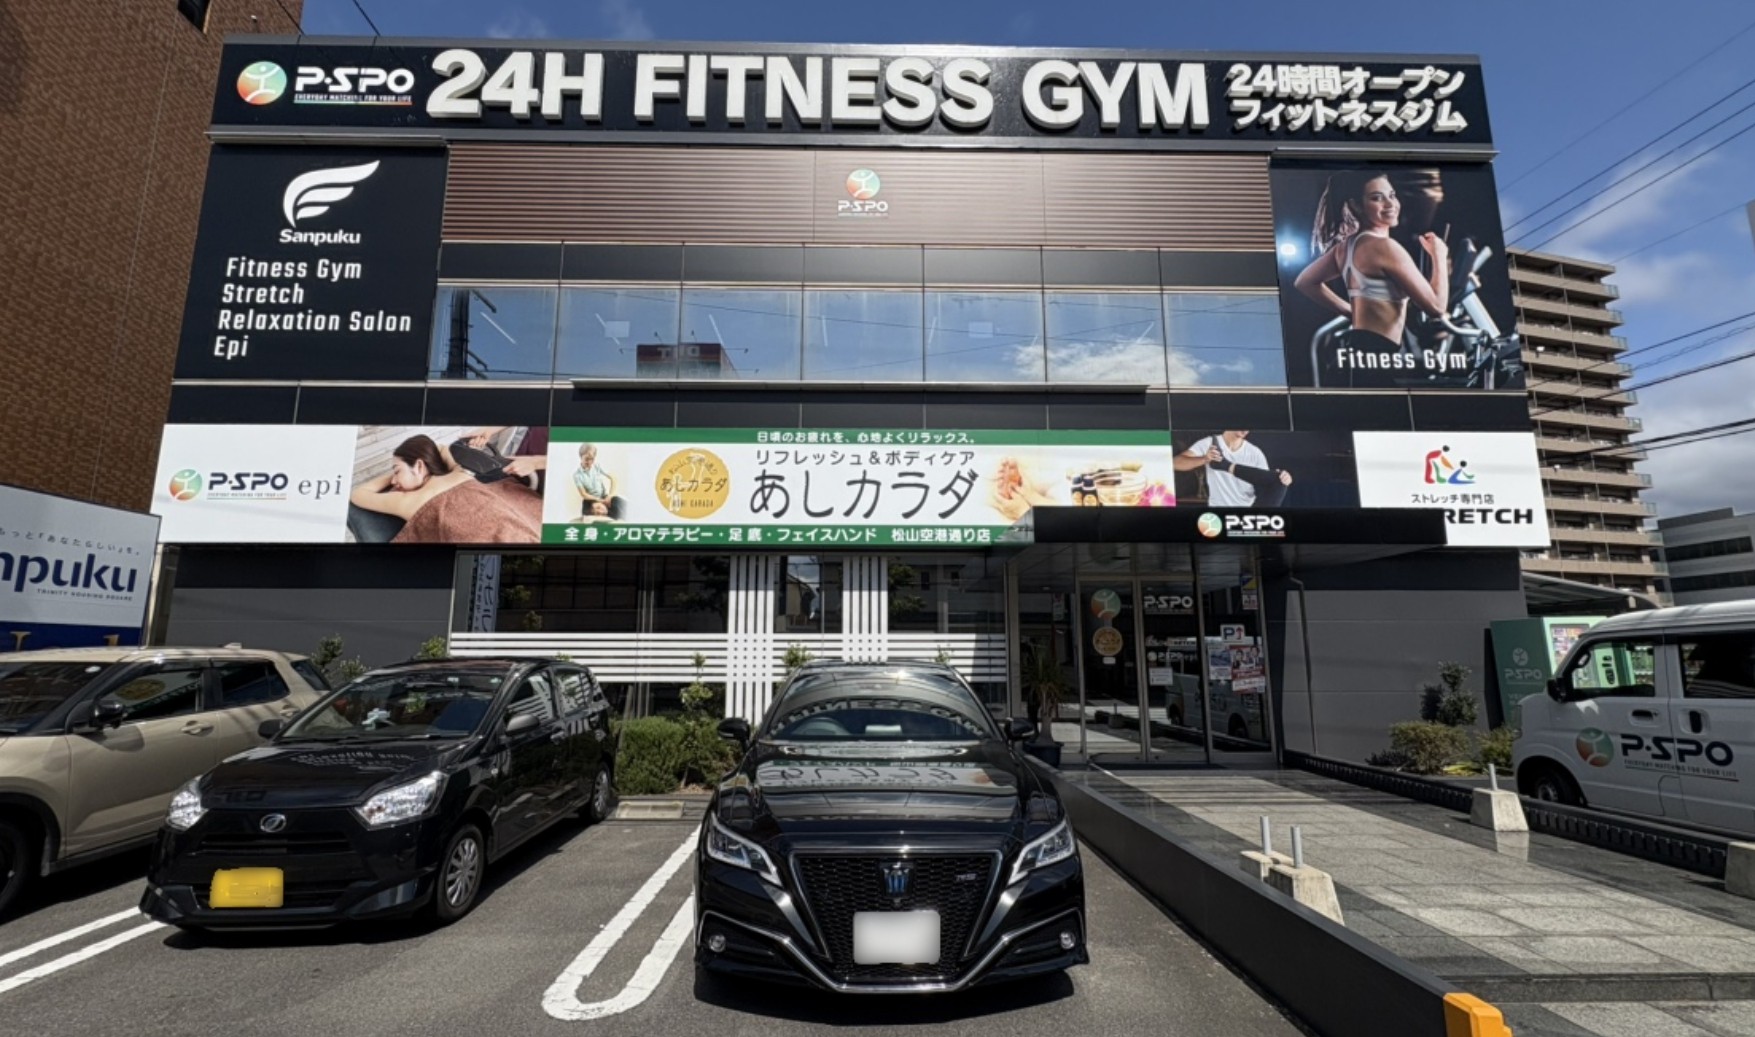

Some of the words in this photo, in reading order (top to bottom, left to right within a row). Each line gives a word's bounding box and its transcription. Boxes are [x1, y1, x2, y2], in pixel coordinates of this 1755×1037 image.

[426, 48, 604, 122] 24H
[633, 53, 995, 130] FITNESS
[1022, 58, 1210, 131] GYM
[1224, 63, 1466, 99] 24時間オープン
[1229, 98, 1468, 133] フィットネスジム
[279, 228, 361, 246] Sanpuku
[225, 256, 308, 278] Fitness
[316, 258, 362, 282] Gym
[221, 283, 304, 304] Stretch
[217, 309, 341, 331] Relaxation
[349, 310, 412, 332] Salon
[213, 335, 249, 360] Epi
[1336, 348, 1416, 369] Fitness
[1423, 350, 1468, 373] Gym
[297, 474, 342, 500] epi
[659, 477, 728, 493] あしカラダ
[749, 468, 979, 519] あしカラダ
[1410, 493, 1495, 505] ストレッチ専門店
[890, 527, 991, 543] 松山空港通り店
[1223, 627, 1235, 640] P
